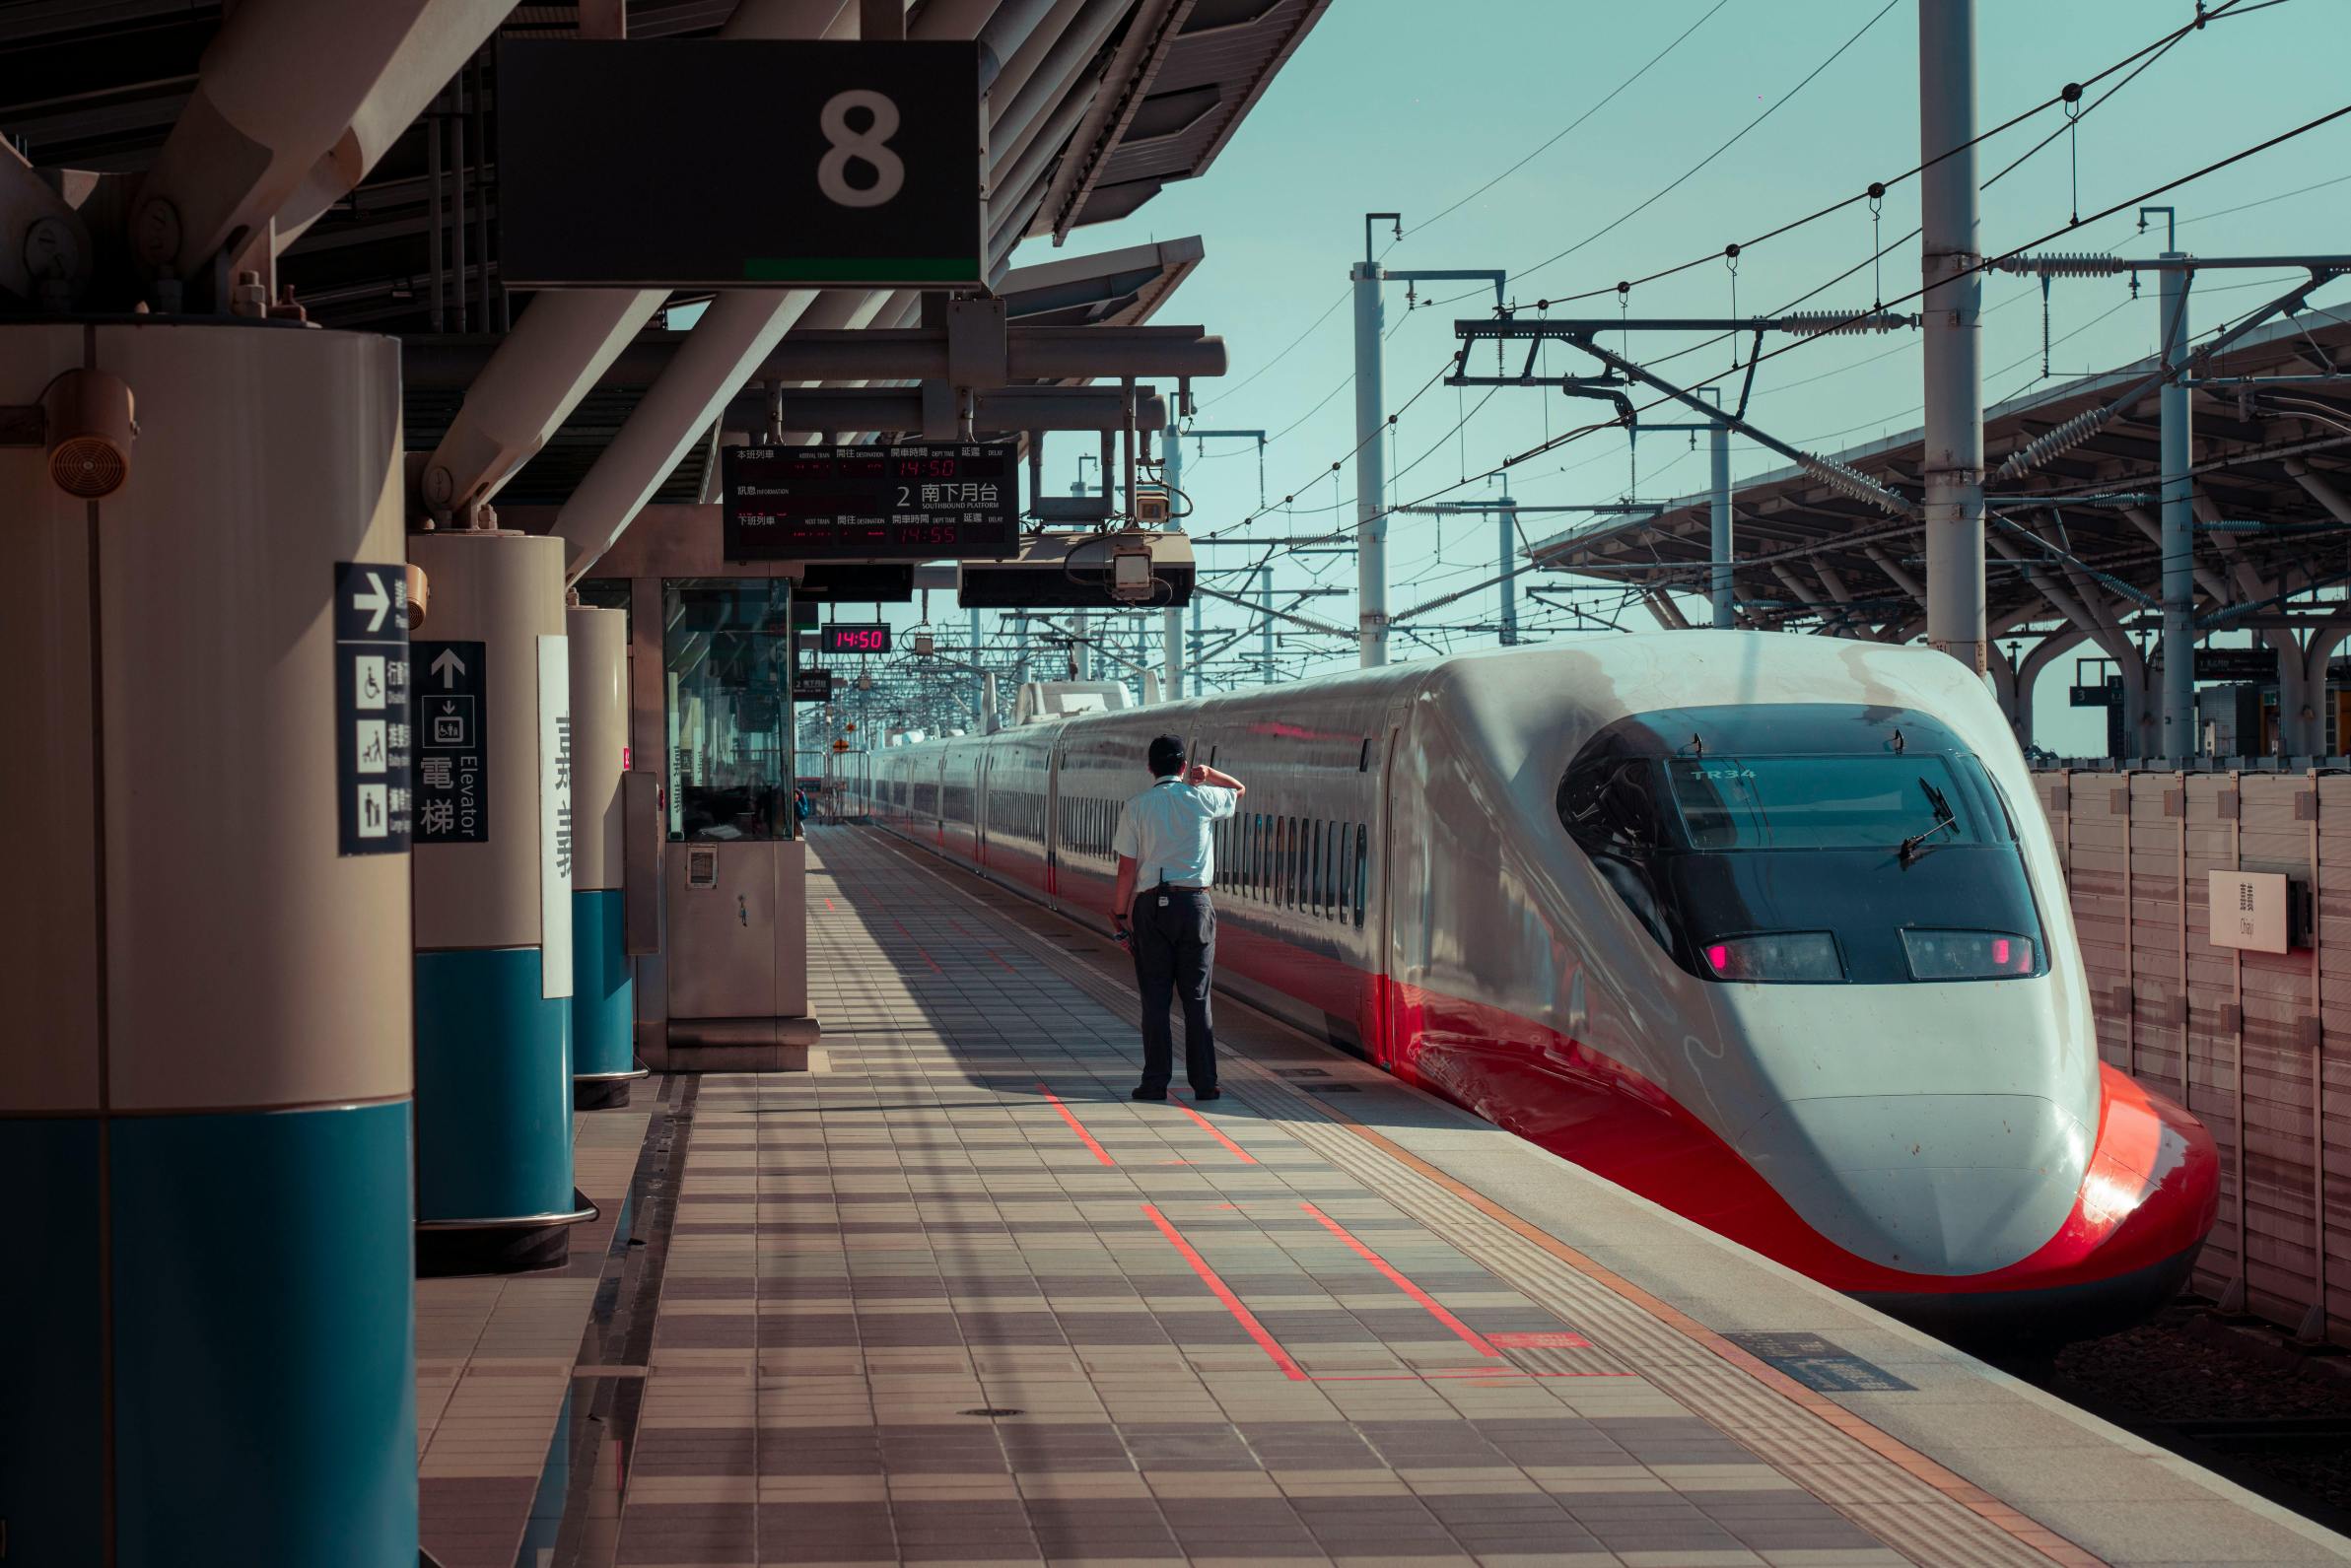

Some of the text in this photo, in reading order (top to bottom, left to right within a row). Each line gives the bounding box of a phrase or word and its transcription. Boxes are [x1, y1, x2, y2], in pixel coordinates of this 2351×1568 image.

[817, 89, 905, 207] 8
[736, 449, 774, 459] 本班列車
[836, 448, 855, 458] 開往
[891, 447, 928, 457] 開車時間
[901, 460, 954, 477] 14:50
[896, 483, 999, 507] 2 南下月台
[837, 515, 856, 525] 開往
[892, 514, 929, 524] 開車時間
[901, 526, 955, 543] 14:55
[836, 630, 882, 648] 14:50
[2078, 690, 2086, 701] 3
[1690, 769, 1758, 781] TR34
[420, 757, 454, 835] 電梯
[460, 756, 478, 837] Elevator
